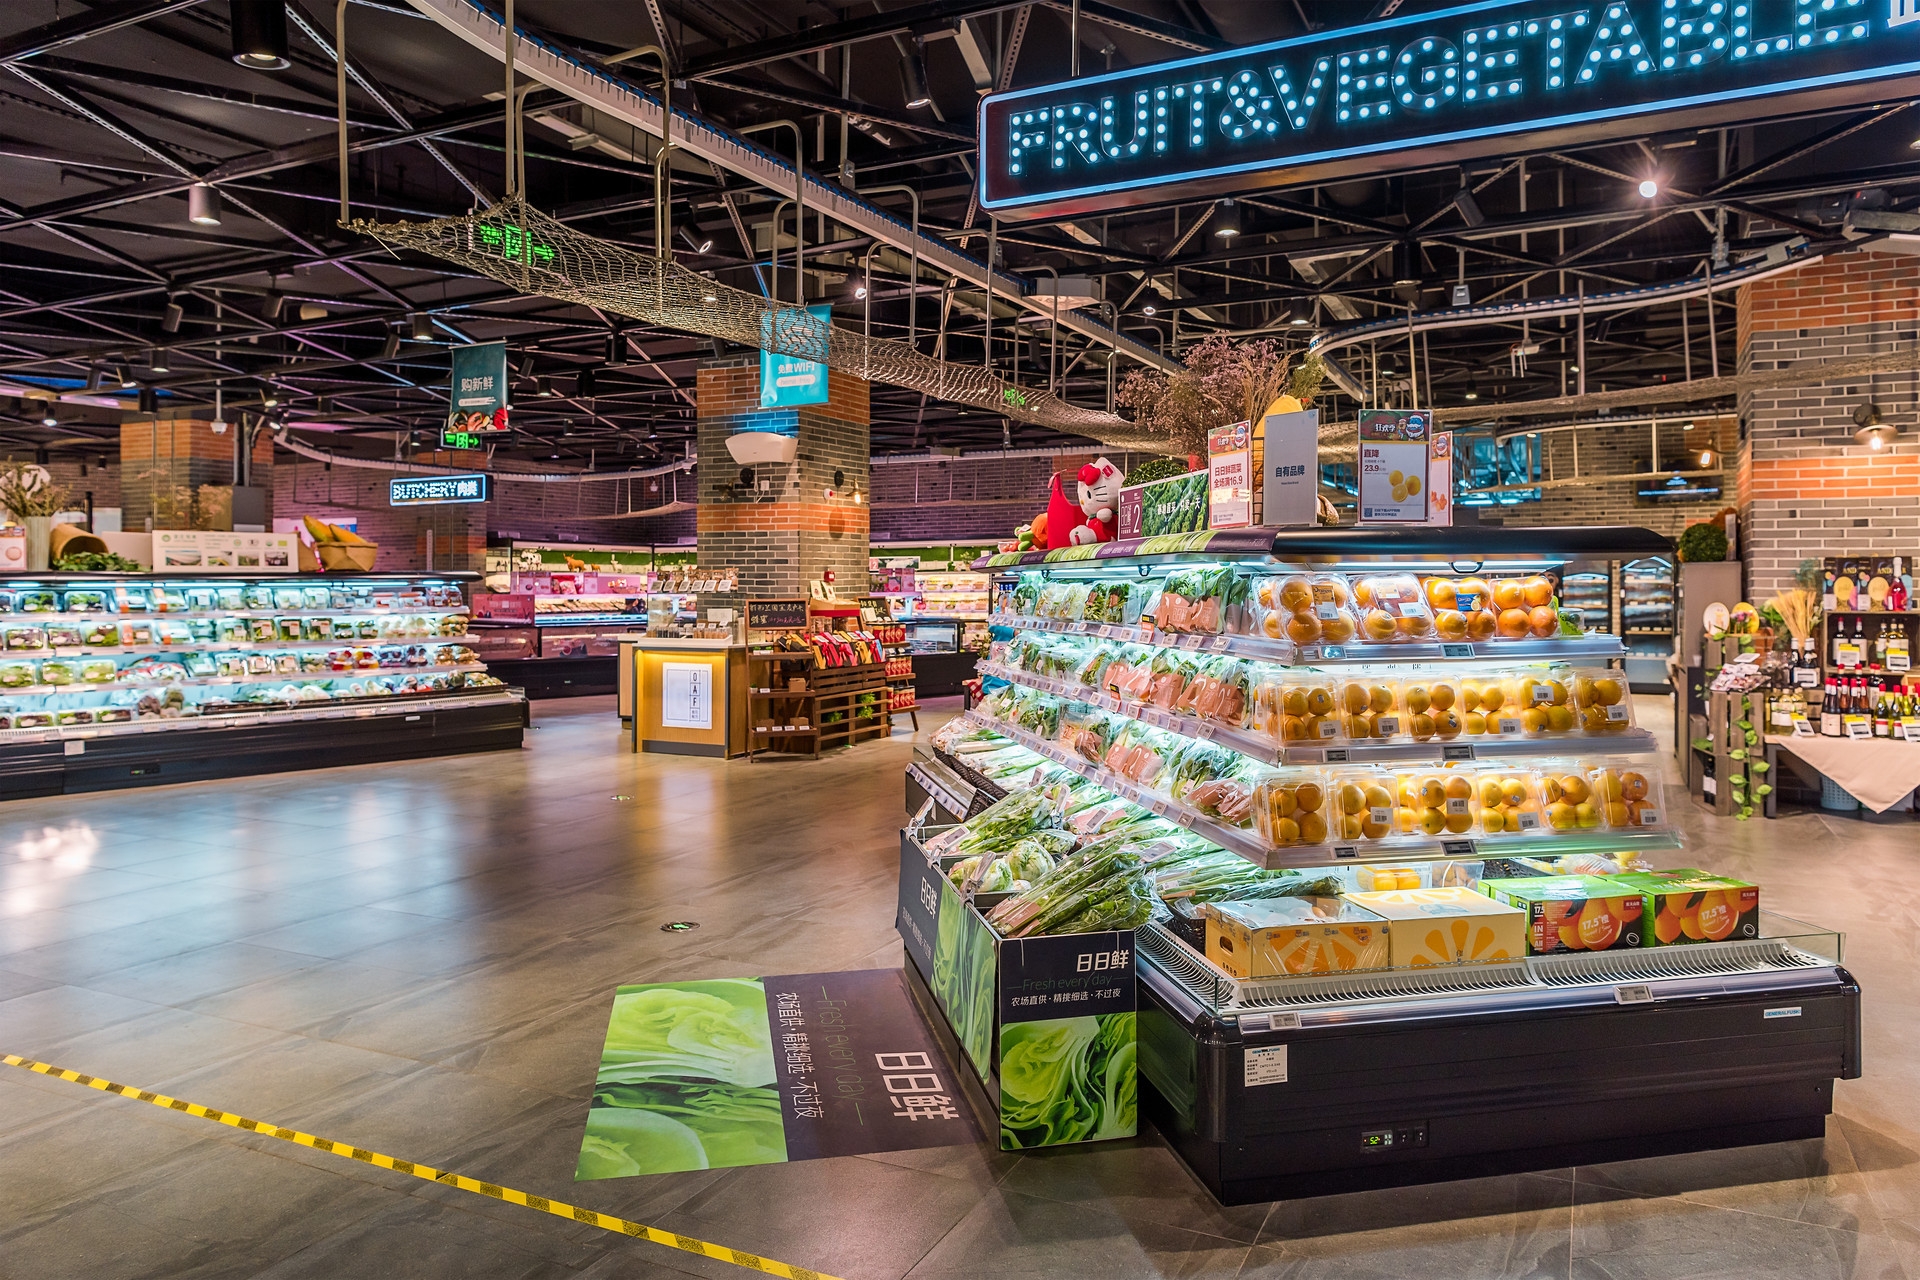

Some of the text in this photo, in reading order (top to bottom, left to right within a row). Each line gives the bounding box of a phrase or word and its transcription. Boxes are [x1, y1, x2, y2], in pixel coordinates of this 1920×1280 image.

[1008, 0, 1870, 175] FRUIT&VEGETABLE
[461, 376, 494, 391] 购新鲜
[1275, 465, 1305, 477] 自有品牌
[1076, 949, 1130, 973] 日日鲜
[1022, 978, 1056, 992] Fresh
[1091, 972, 1113, 986] day
[816, 1000, 872, 1101] Fresh every day
[874, 1051, 960, 1122] 日日鲜
